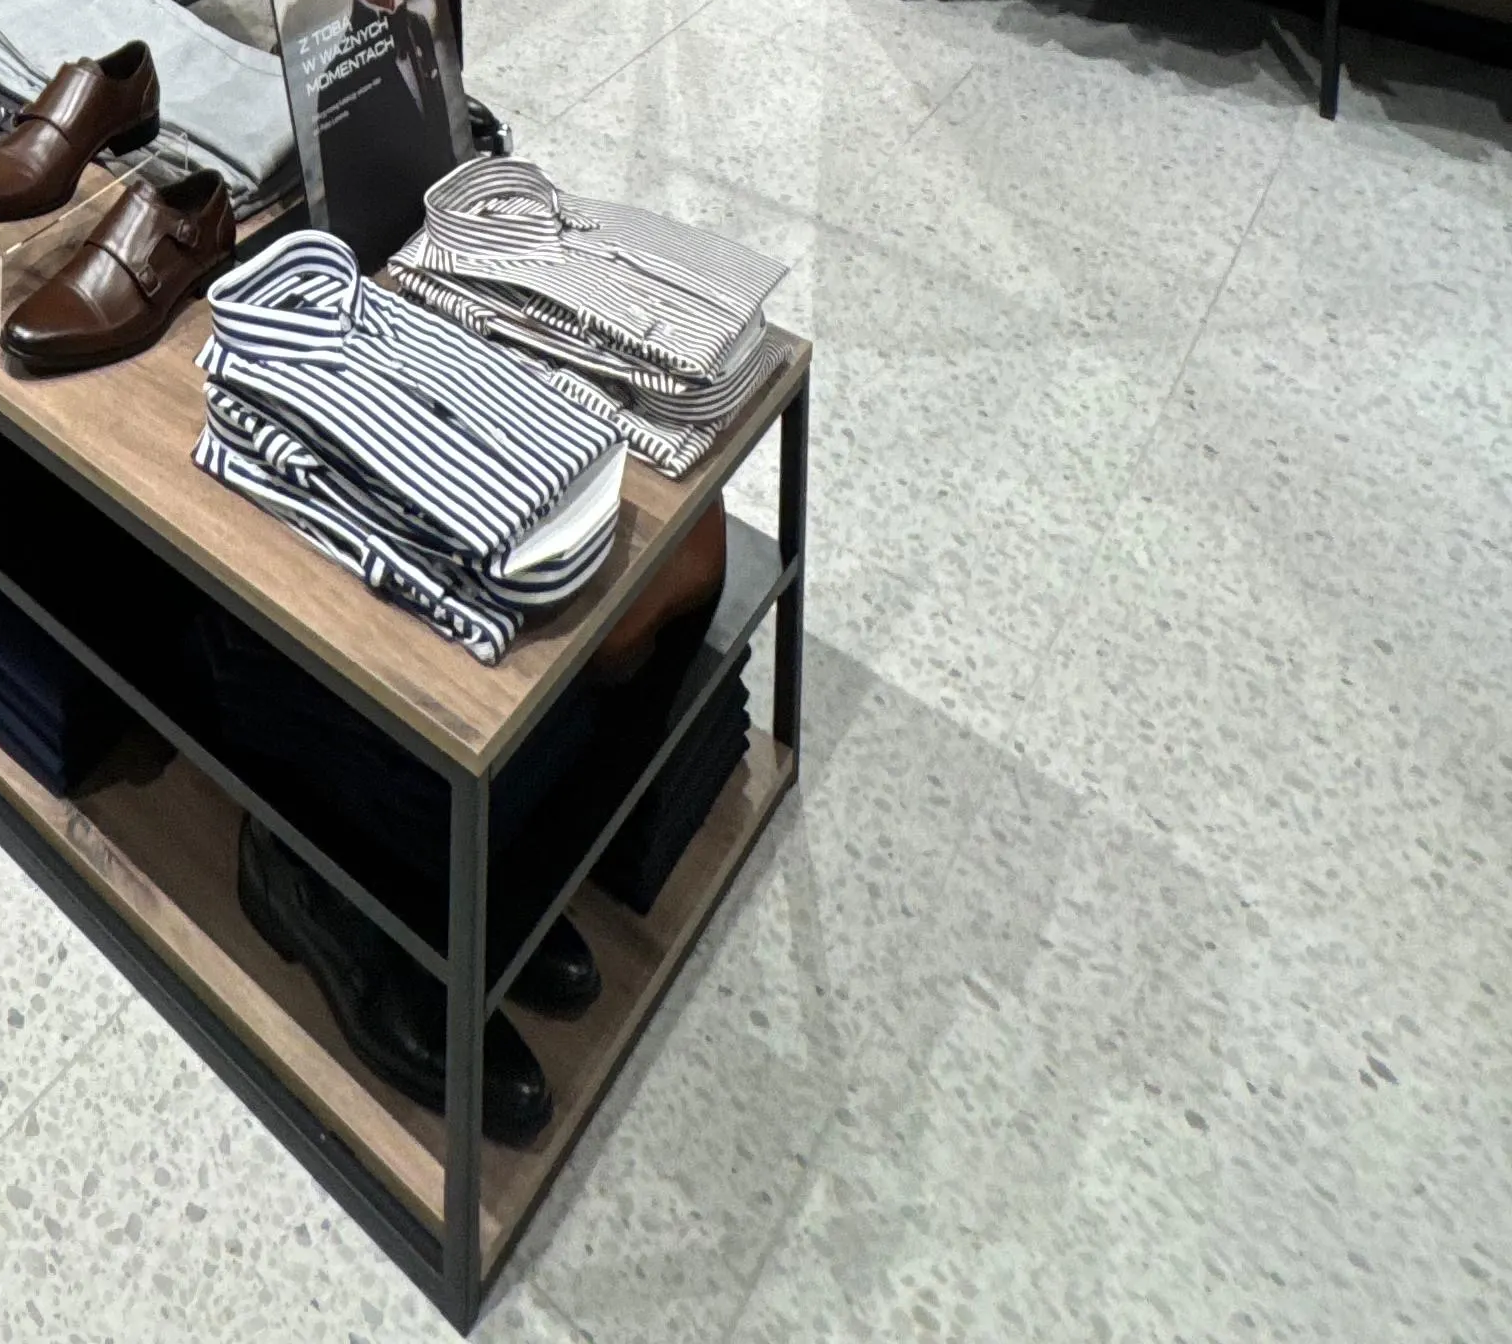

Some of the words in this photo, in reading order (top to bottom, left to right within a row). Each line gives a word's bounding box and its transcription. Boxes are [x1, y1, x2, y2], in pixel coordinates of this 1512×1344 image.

[298, 37, 310, 54] Z
[301, 56, 316, 75] W
[306, 34, 395, 96] MOMENTACH
